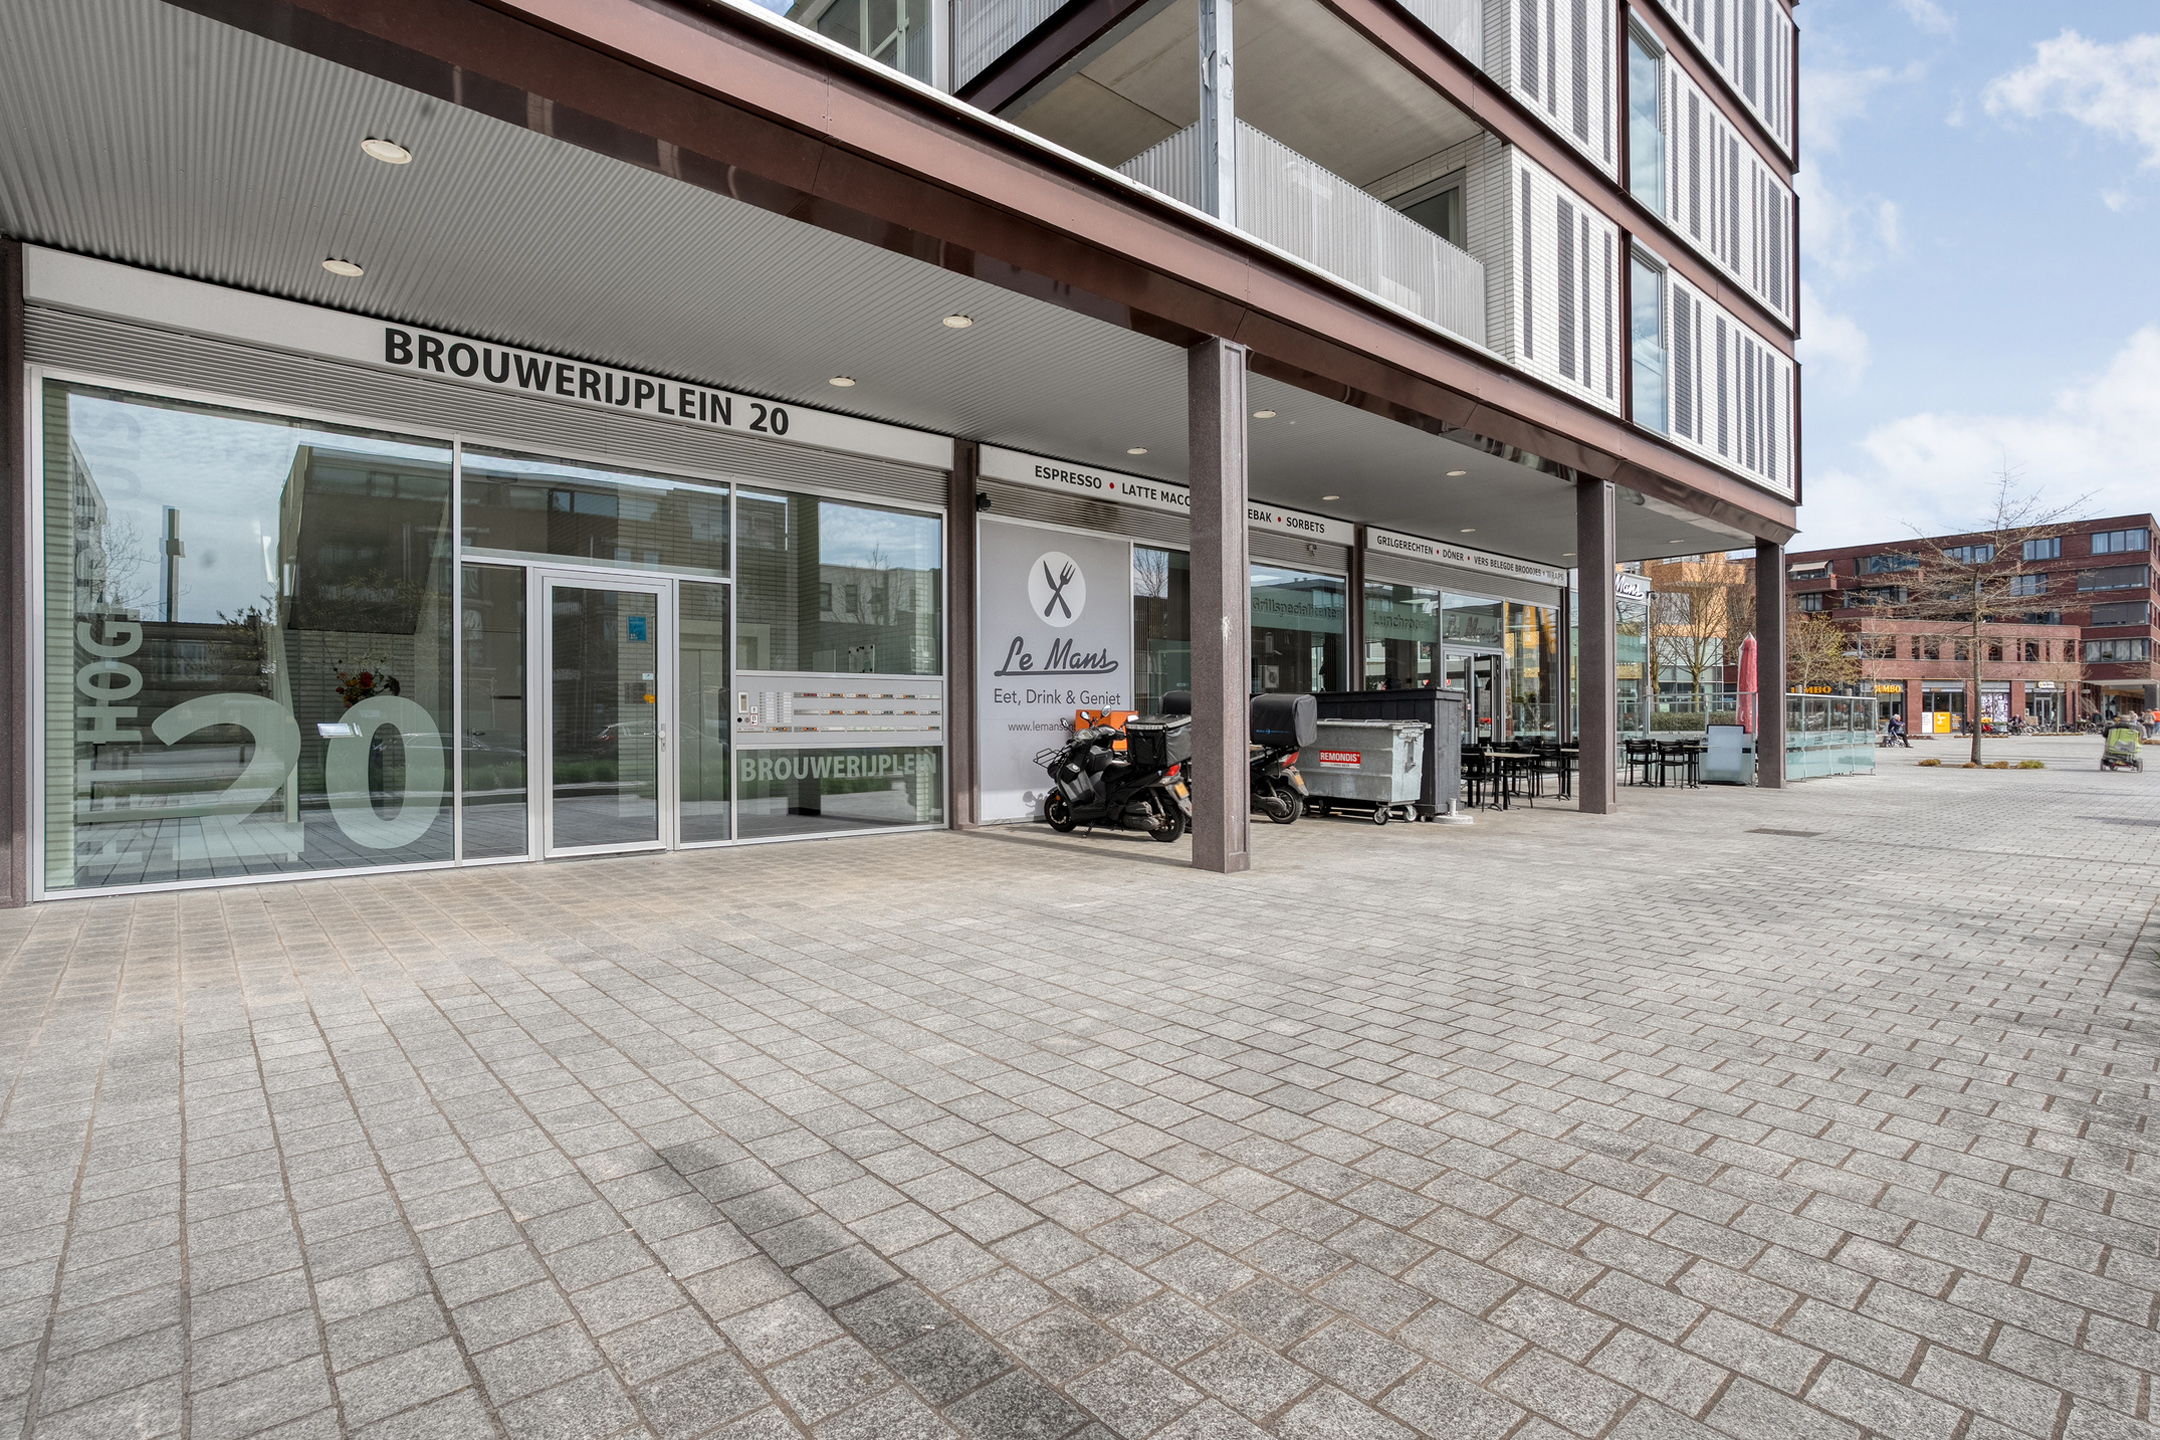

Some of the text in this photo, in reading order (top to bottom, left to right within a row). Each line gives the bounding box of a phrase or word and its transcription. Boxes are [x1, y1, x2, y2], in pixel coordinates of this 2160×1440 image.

[385, 327, 790, 436] BROUWERIJPLEIN 20
[1034, 464, 1102, 490] ESPRESSO
[1121, 482, 1157, 500] LATTE
[1286, 516, 1325, 534] SORBETS
[1376, 535, 1434, 556] GRILGERECHTEN
[1442, 548, 1465, 562] DÖNER
[1473, 555, 1489, 567] VERS
[1490, 559, 1515, 572] BELEGDE
[1514, 564, 1542, 577] BROODJES
[994, 636, 1119, 677] Le Mans
[994, 688, 1121, 706] Eet, Drink & Geniet
[1790, 685, 1832, 694] JMBO
[151, 692, 445, 861] 20
[741, 753, 937, 782] BROUWERIJPLEIN
